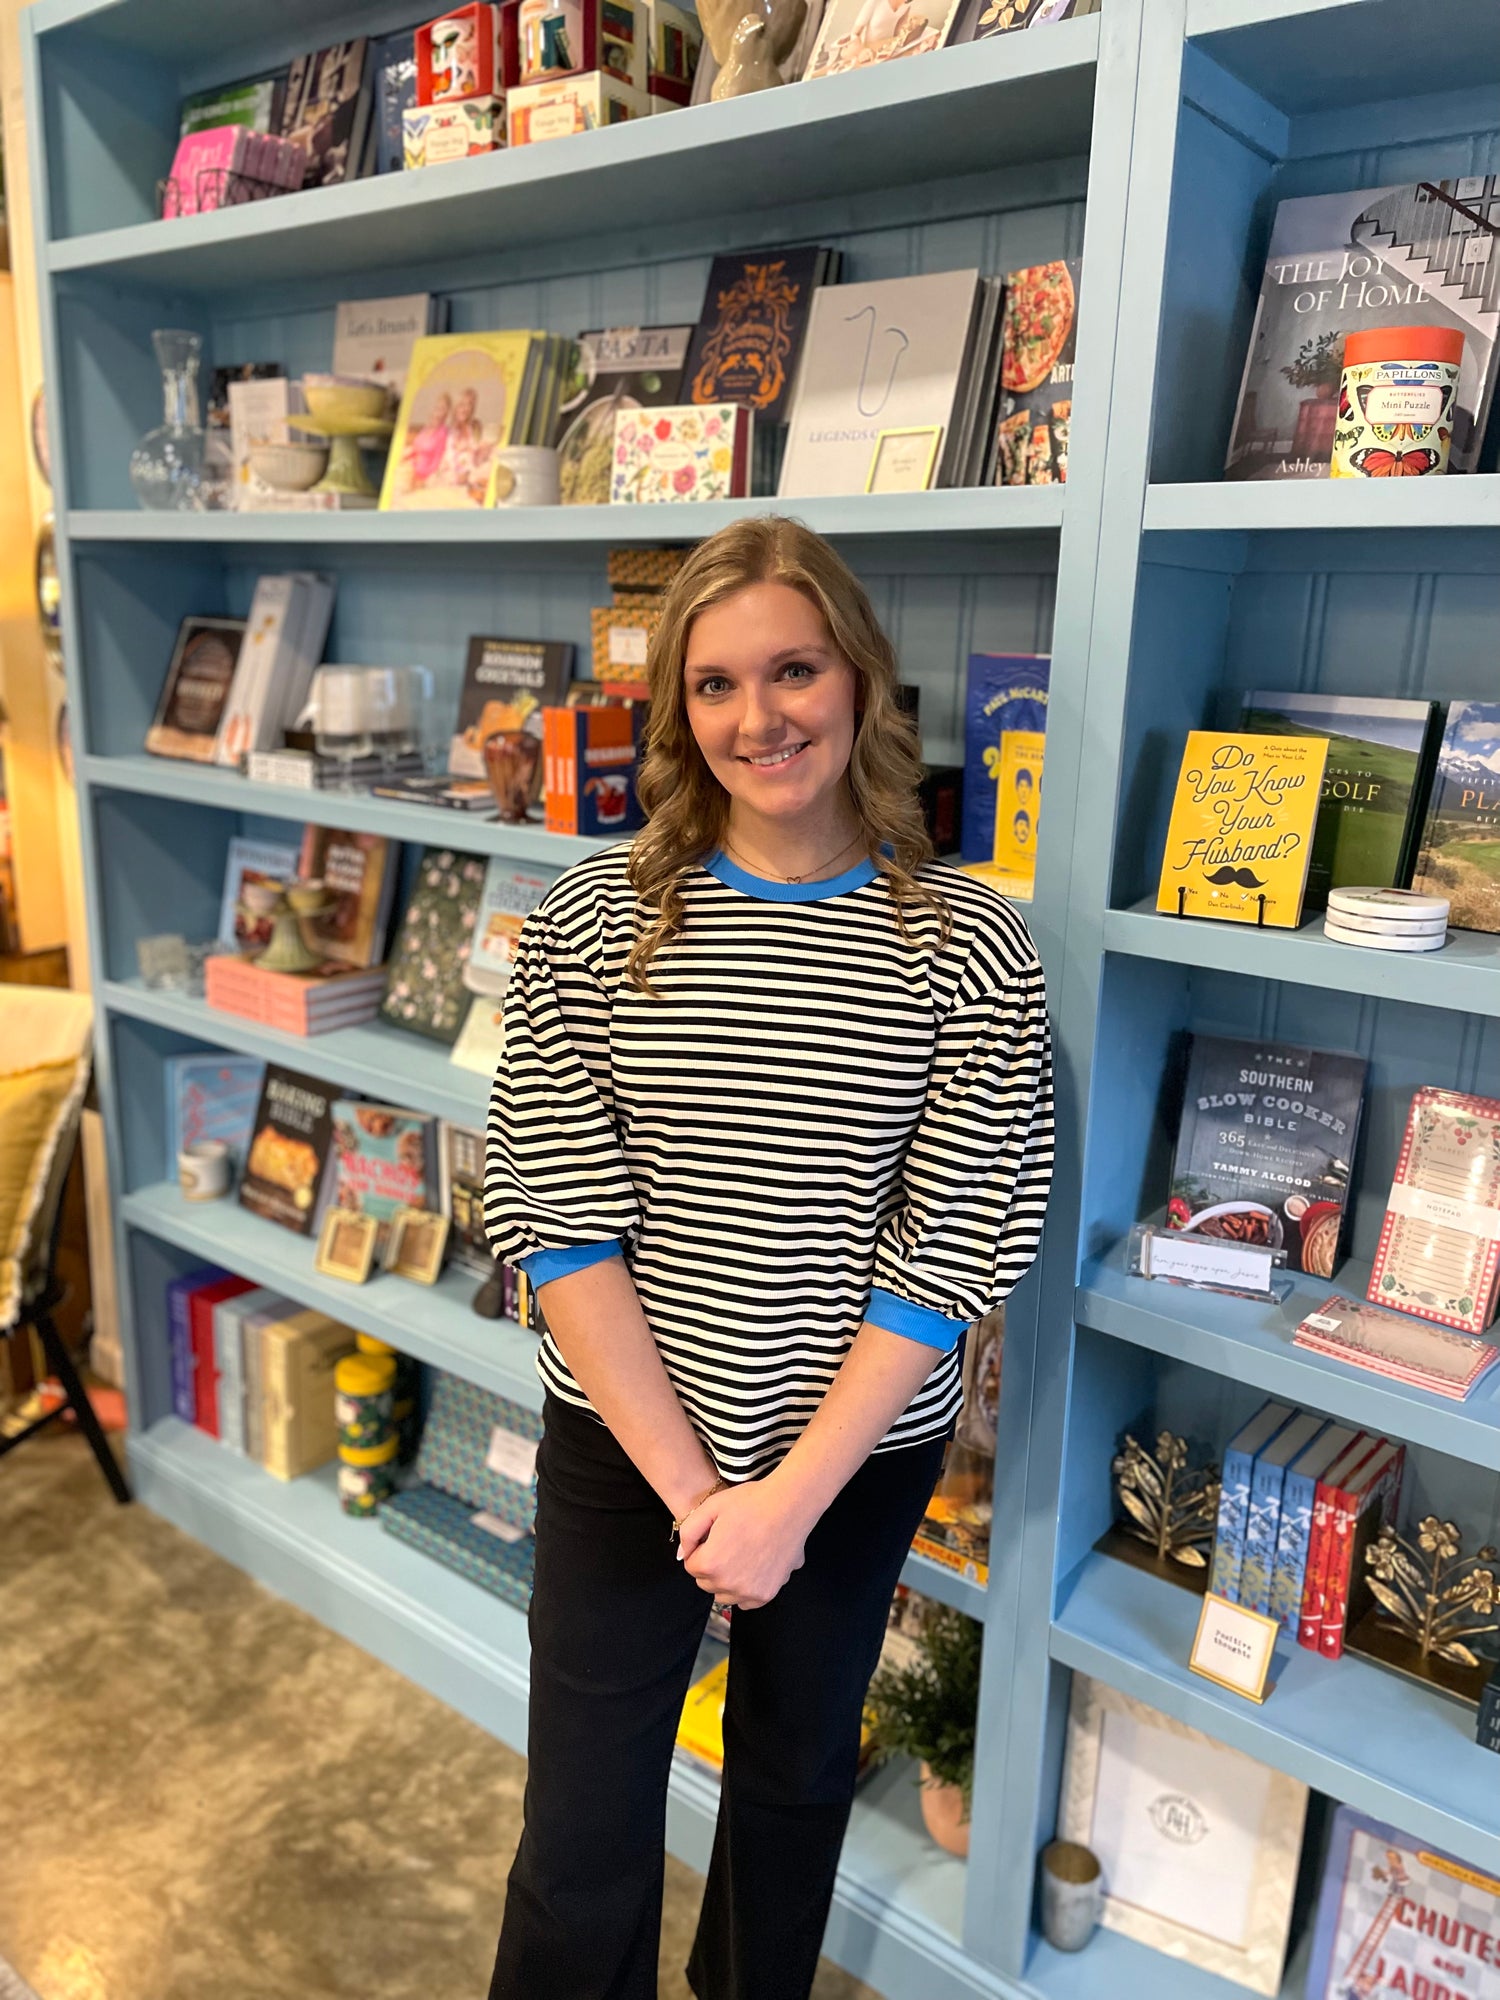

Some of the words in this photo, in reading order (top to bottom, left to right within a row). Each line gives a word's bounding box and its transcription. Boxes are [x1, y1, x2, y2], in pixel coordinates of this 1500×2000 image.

[1275, 259, 1333, 285] THE
[1336, 252, 1388, 285] JOY
[1294, 290, 1333, 314] OF
[1338, 281, 1432, 309] HOME
[1376, 370, 1442, 380] PAPILLONS
[1381, 401, 1402, 409] Mini
[1404, 401, 1431, 409] Puzzle
[809, 431, 868, 443] LEGENDS
[1275, 457, 1325, 481] Ashley
[1211, 745, 1254, 771] Do
[1323, 767, 1350, 776] CES
[1357, 770, 1372, 778] TO
[1186, 769, 1236, 803] You
[1233, 765, 1305, 805] Know
[1319, 779, 1381, 801] GOLF
[1213, 800, 1275, 835] Your
[1343, 805, 1364, 813] DIE
[1172, 833, 1300, 871] Husband?
[1220, 891, 1229, 899] No
[1267, 1055, 1292, 1065] THE
[1239, 1069, 1314, 1093] SOUTHERN
[1197, 1093, 1257, 1110] SLOW
[1262, 1095, 1347, 1135] COOKER
[1244, 1114, 1297, 1131] BIBLE
[1218, 1131, 1245, 1148] 365
[1212, 1162, 1259, 1177] TAMMY
[1261, 1171, 1312, 1188] ALGOOD
[1427, 1204, 1462, 1217] NOTEPAD
[1432, 1956, 1465, 1980] and
